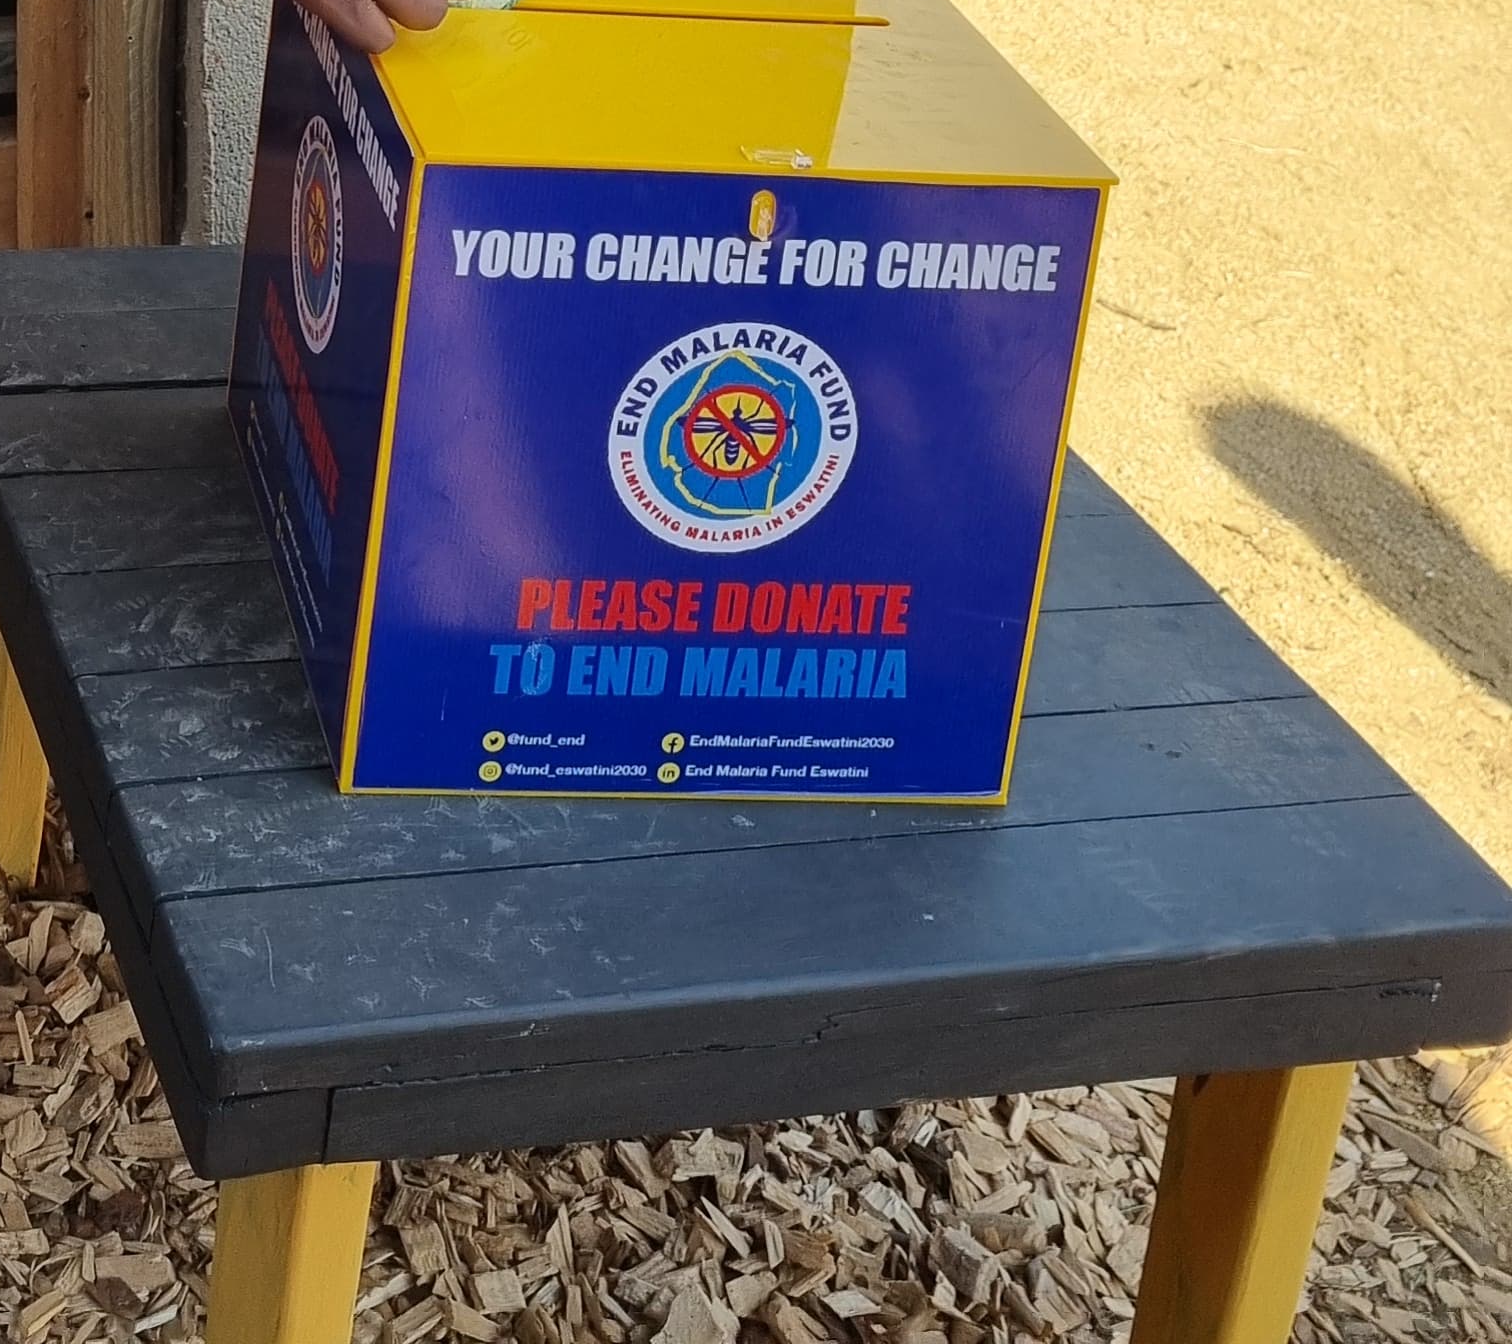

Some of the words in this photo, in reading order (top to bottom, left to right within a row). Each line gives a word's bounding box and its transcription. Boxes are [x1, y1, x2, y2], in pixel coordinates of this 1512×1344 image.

[338, 62, 359, 138] FOR
[356, 106, 401, 233] CHANGE
[452, 230, 576, 279] YOUR
[585, 233, 771, 285] CHANGE
[779, 238, 869, 287] FOR
[876, 241, 1061, 291] CHANGE
[617, 376, 659, 437] END
[660, 329, 810, 374] MALARIA
[809, 361, 851, 441] FUND
[620, 451, 681, 532] ELIMINATING
[685, 526, 762, 542] MALARIA
[765, 516, 784, 531] IN
[786, 454, 840, 520] ESWATINI
[516, 579, 703, 632] PLEASE
[712, 581, 912, 634] DONATE
[489, 643, 556, 696] TO
[567, 645, 669, 697] END
[679, 647, 908, 699] MALARIA
[507, 733, 586, 748] @fund_end
[689, 734, 895, 749] EndMalariaFundEswatini2030
[685, 764, 713, 777] End
[716, 765, 768, 778] Malaria
[771, 765, 806, 778] Fund
[809, 766, 869, 778] Eswatini
